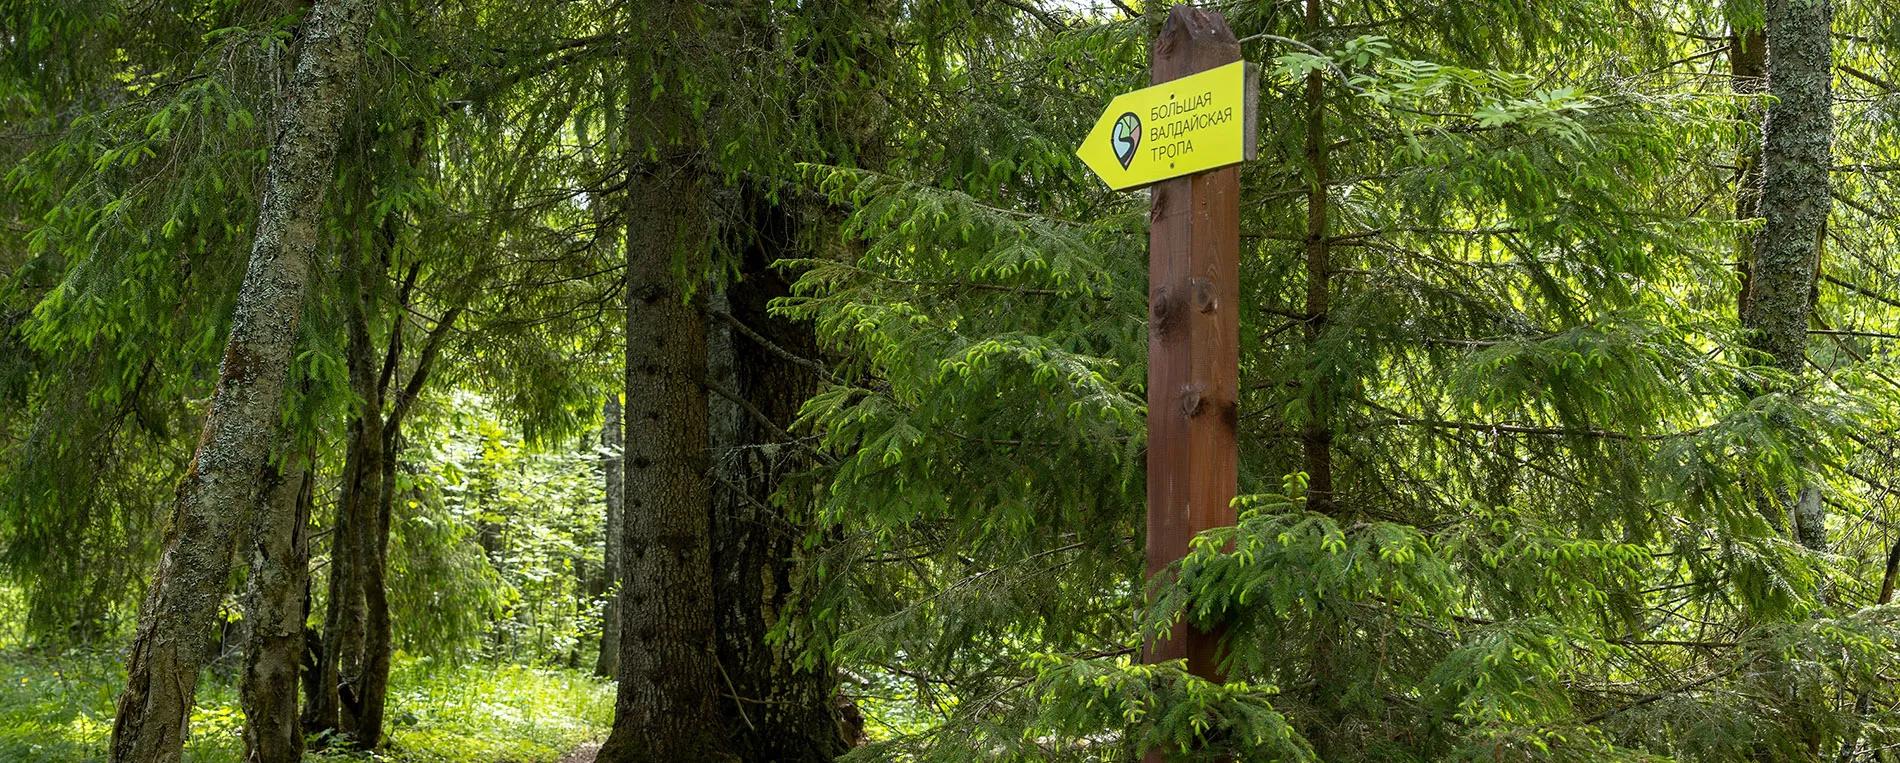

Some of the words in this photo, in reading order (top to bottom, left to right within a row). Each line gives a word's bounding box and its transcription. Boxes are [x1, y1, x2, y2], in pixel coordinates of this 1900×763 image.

[1151, 92, 1212, 121] БОЛЬШАЯ
[1150, 107, 1232, 142] ВАЛДАЙСКАЯ
[1151, 139, 1193, 162] ТРОПА
